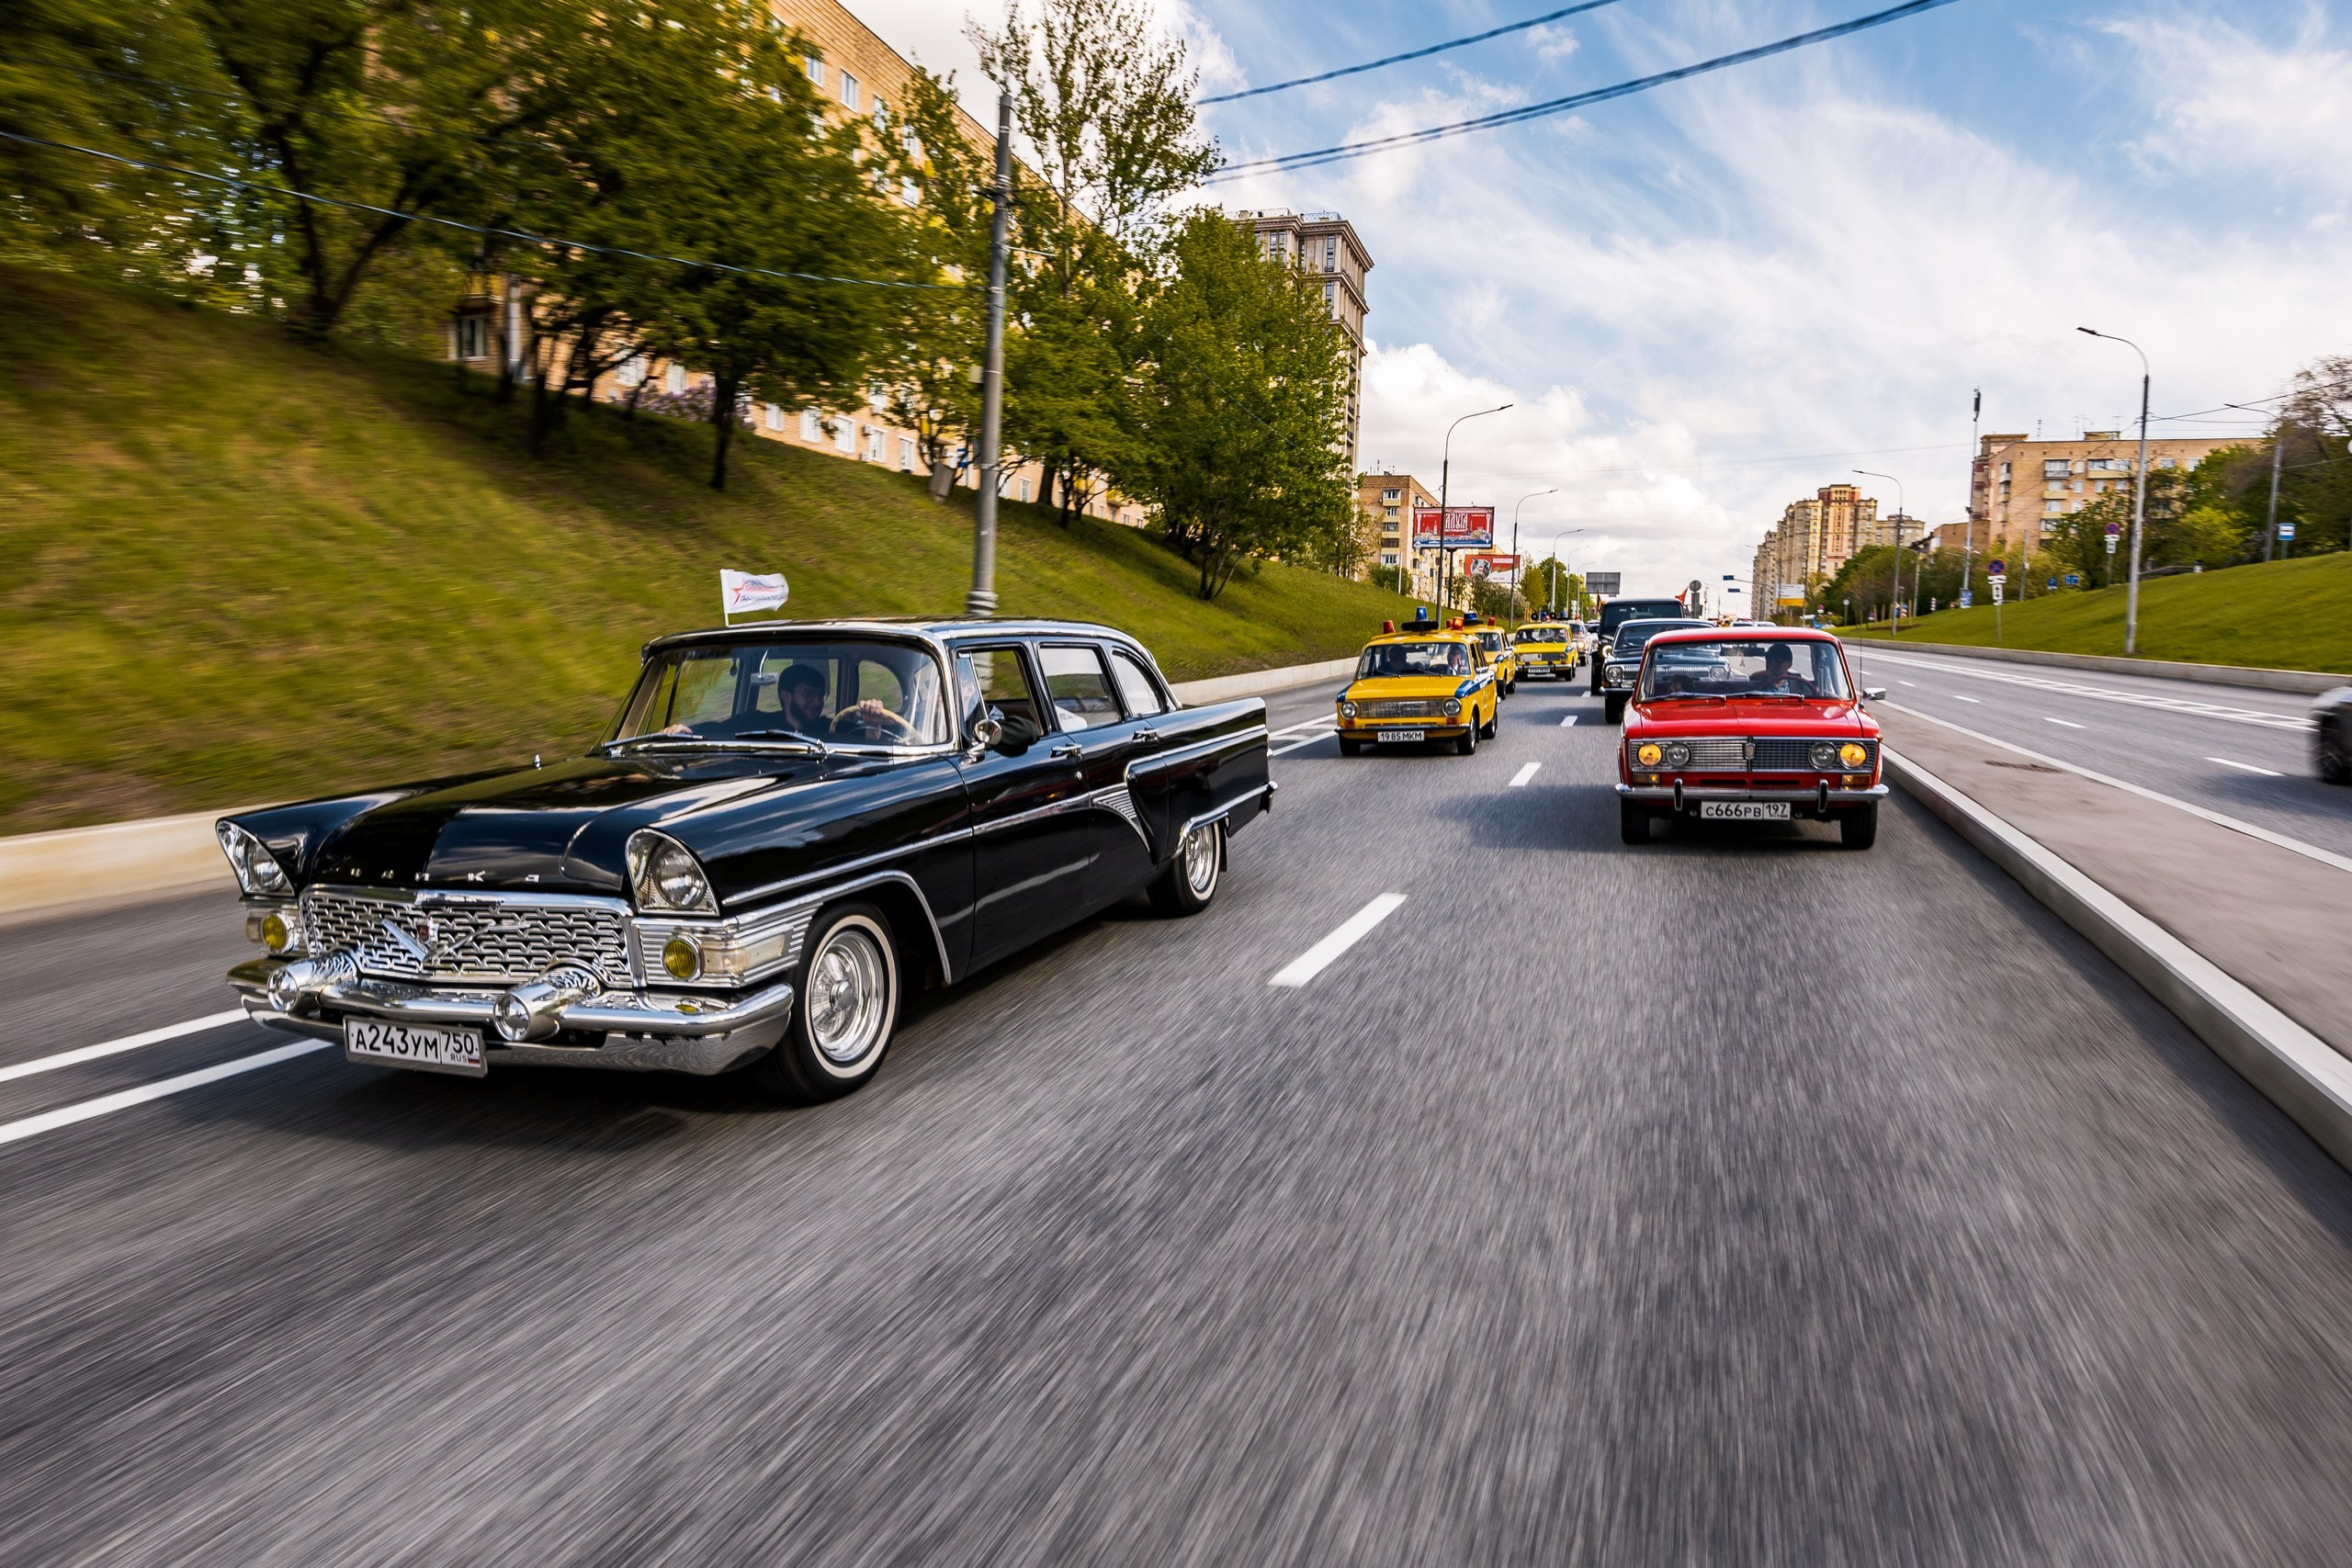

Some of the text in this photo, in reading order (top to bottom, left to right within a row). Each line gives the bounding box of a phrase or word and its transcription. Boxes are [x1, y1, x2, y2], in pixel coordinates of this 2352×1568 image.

[1444, 513, 1468, 529] АЛУГА
[1705, 803, 1788, 818] С666РВ 197
[355, 1024, 475, 1059] А243УМ 750
[450, 1053, 468, 1064] RUS
